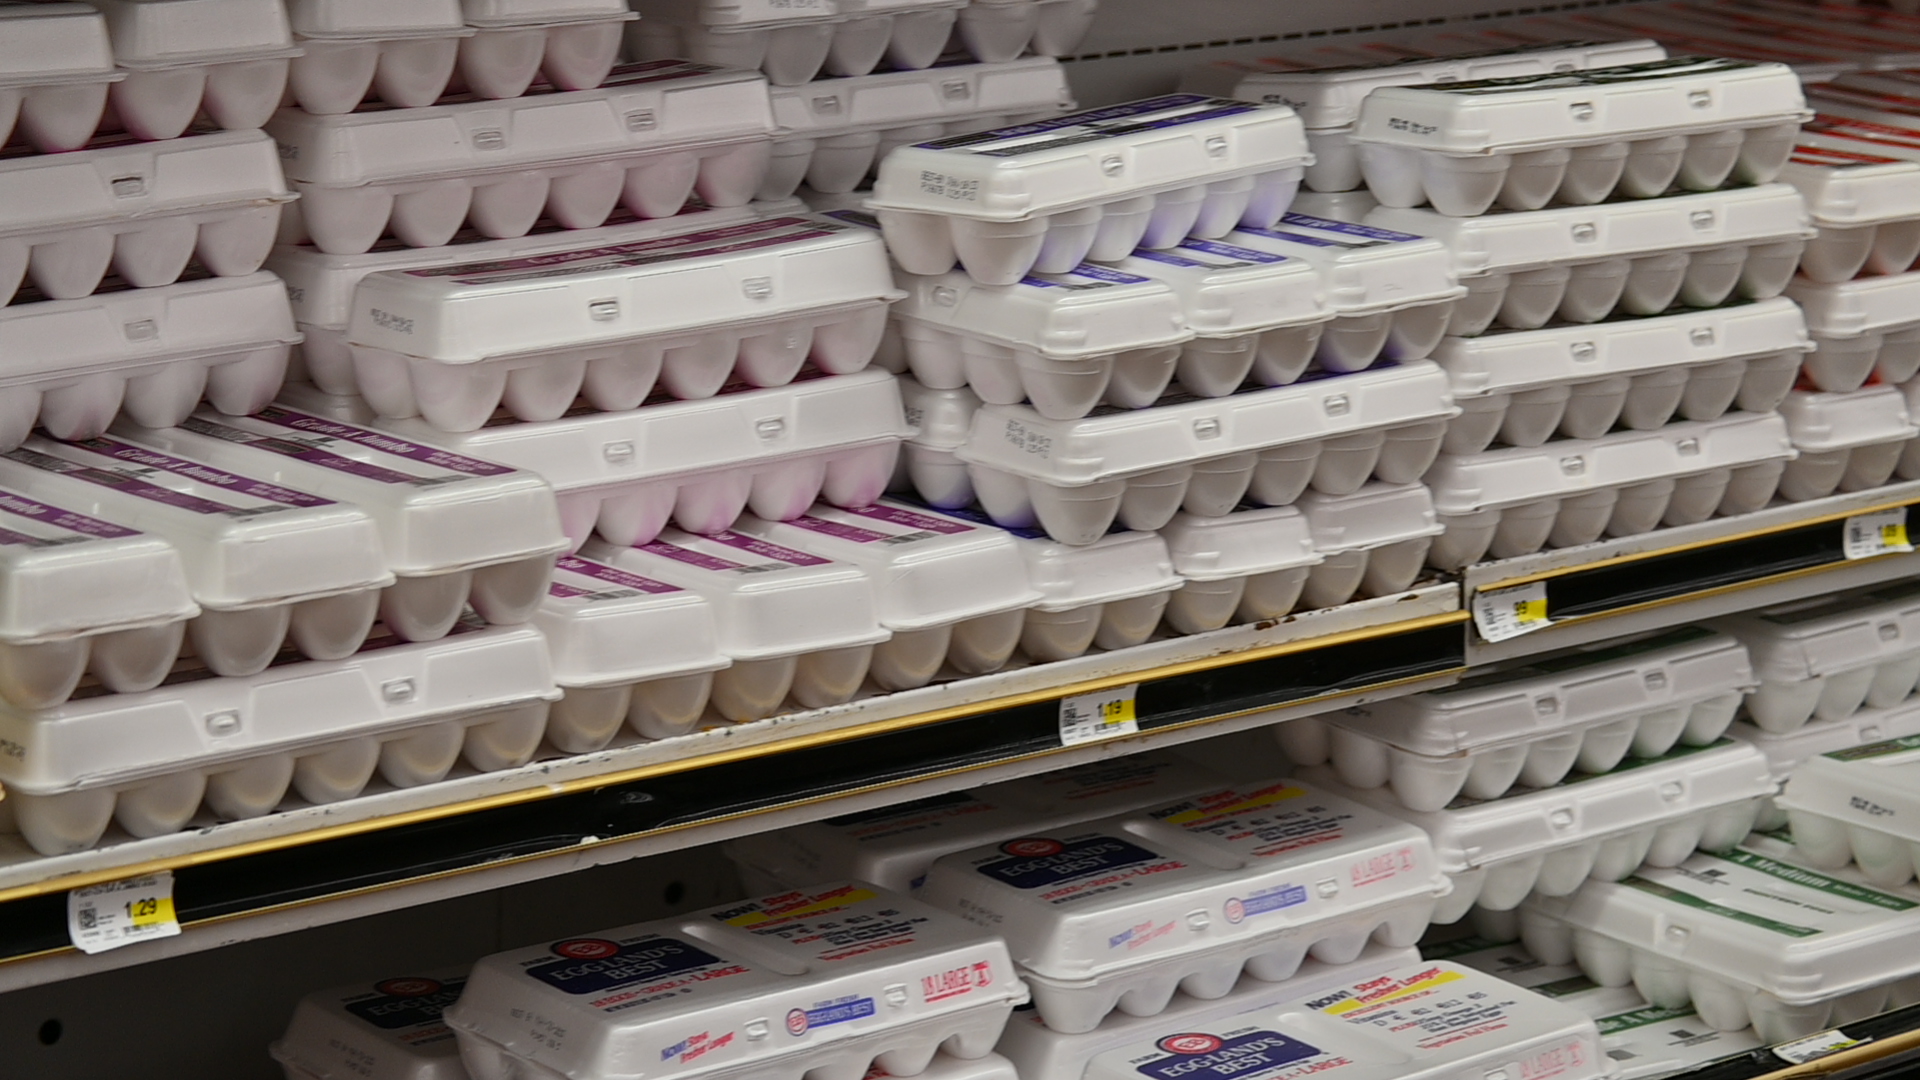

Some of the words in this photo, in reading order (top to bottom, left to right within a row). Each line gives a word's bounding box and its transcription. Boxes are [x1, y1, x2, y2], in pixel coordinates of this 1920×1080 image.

[290, 417, 345, 436] Grade
[357, 433, 417, 453] Jumbo
[114, 448, 170, 464] Grade
[174, 464, 239, 485] Jumbo
[1052, 856, 1113, 876] BEST
[1754, 858, 1833, 889] Medium
[124, 896, 157, 919] 1.29
[603, 958, 670, 981] BEST
[690, 964, 751, 983] LARGE
[936, 966, 973, 993] LARGE
[1304, 989, 1354, 1011] NOW!
[1353, 975, 1393, 993] Stays
[1354, 983, 1402, 1004] Fresher
[1397, 967, 1444, 987] Longer
[1209, 1051, 1274, 1075] BEST
[1298, 1056, 1354, 1076] LARGE
